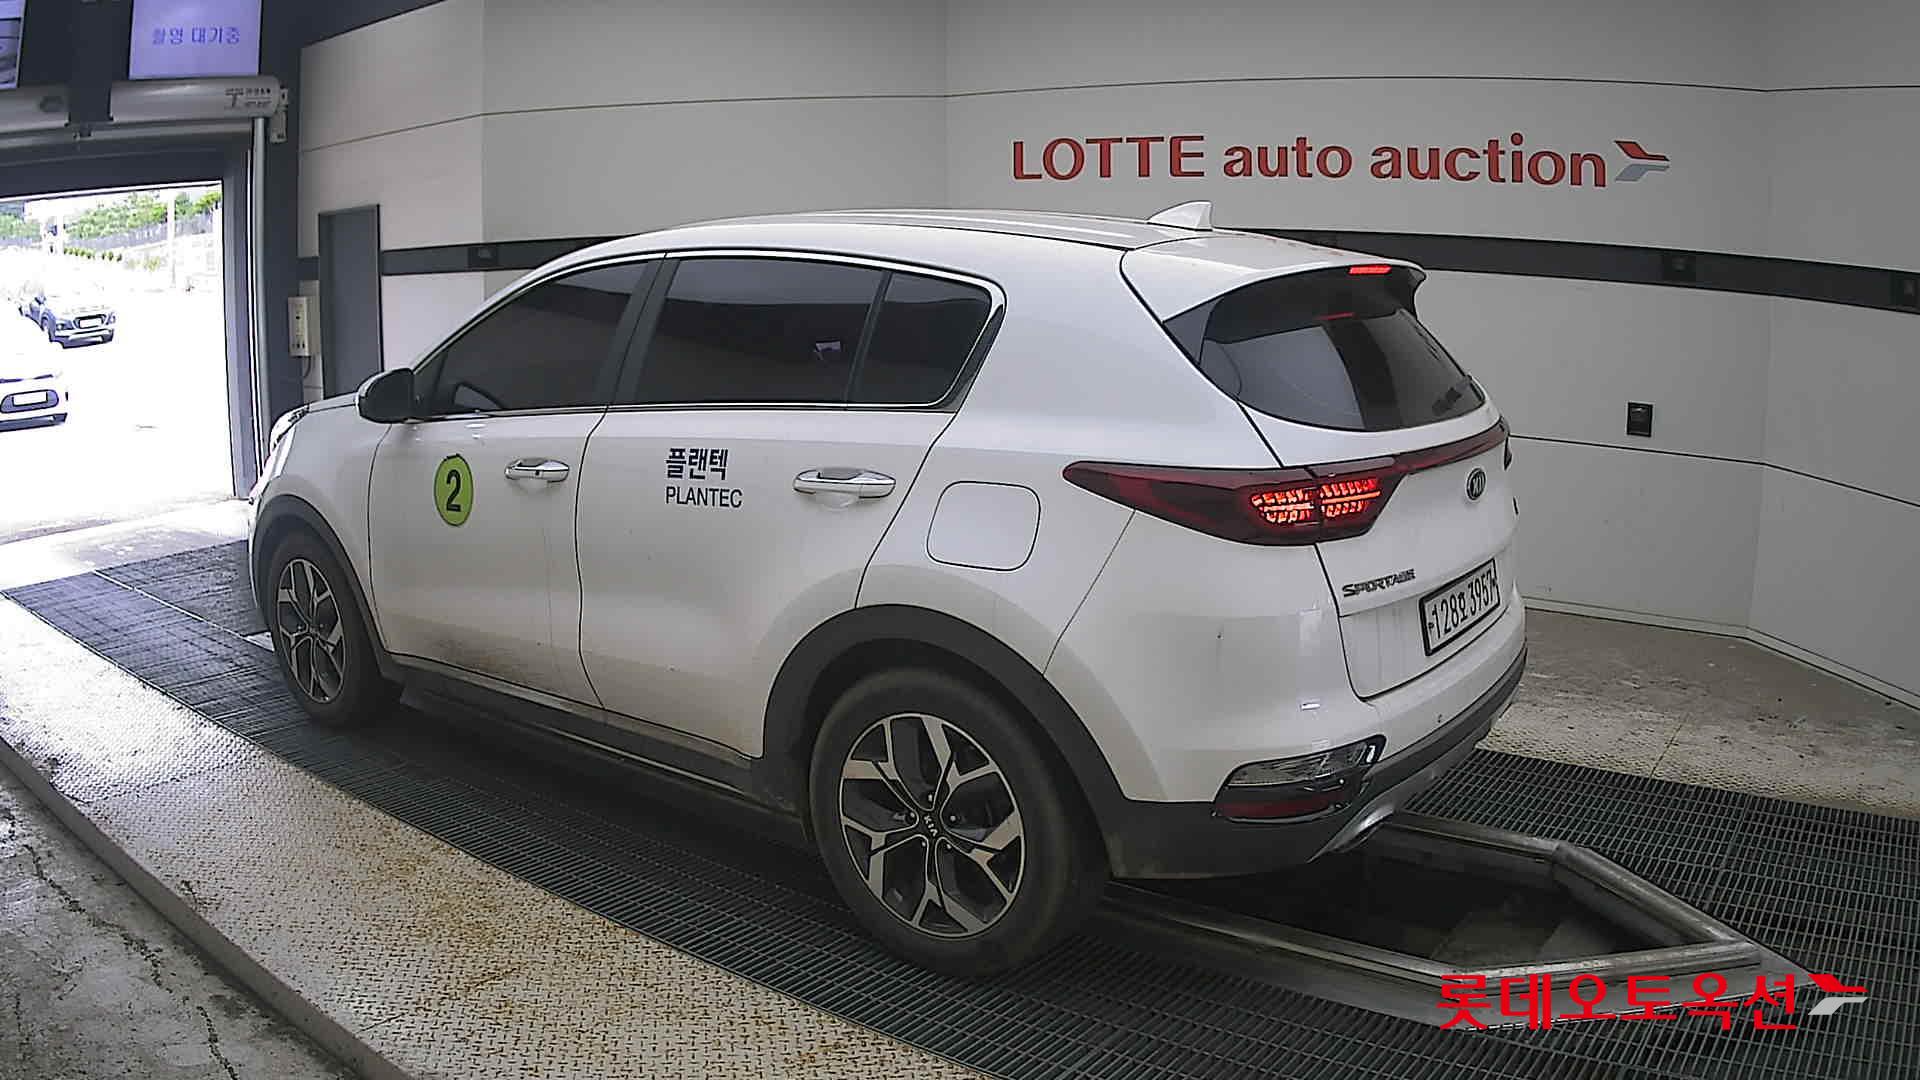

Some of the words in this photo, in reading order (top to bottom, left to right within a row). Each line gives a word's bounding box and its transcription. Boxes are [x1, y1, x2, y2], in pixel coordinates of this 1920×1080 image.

[191, 26, 240, 45] 대기중
[1013, 136, 1205, 180] LOTTE
[1223, 136, 1353, 178] auto
[1370, 132, 1607, 188] auction
[665, 448, 729, 481] 플랜텍
[446, 469, 462, 513] 2
[665, 486, 744, 509] PLANTEC
[1342, 568, 1416, 598] SPORTAGE
[1467, 569, 1494, 616] 3957
